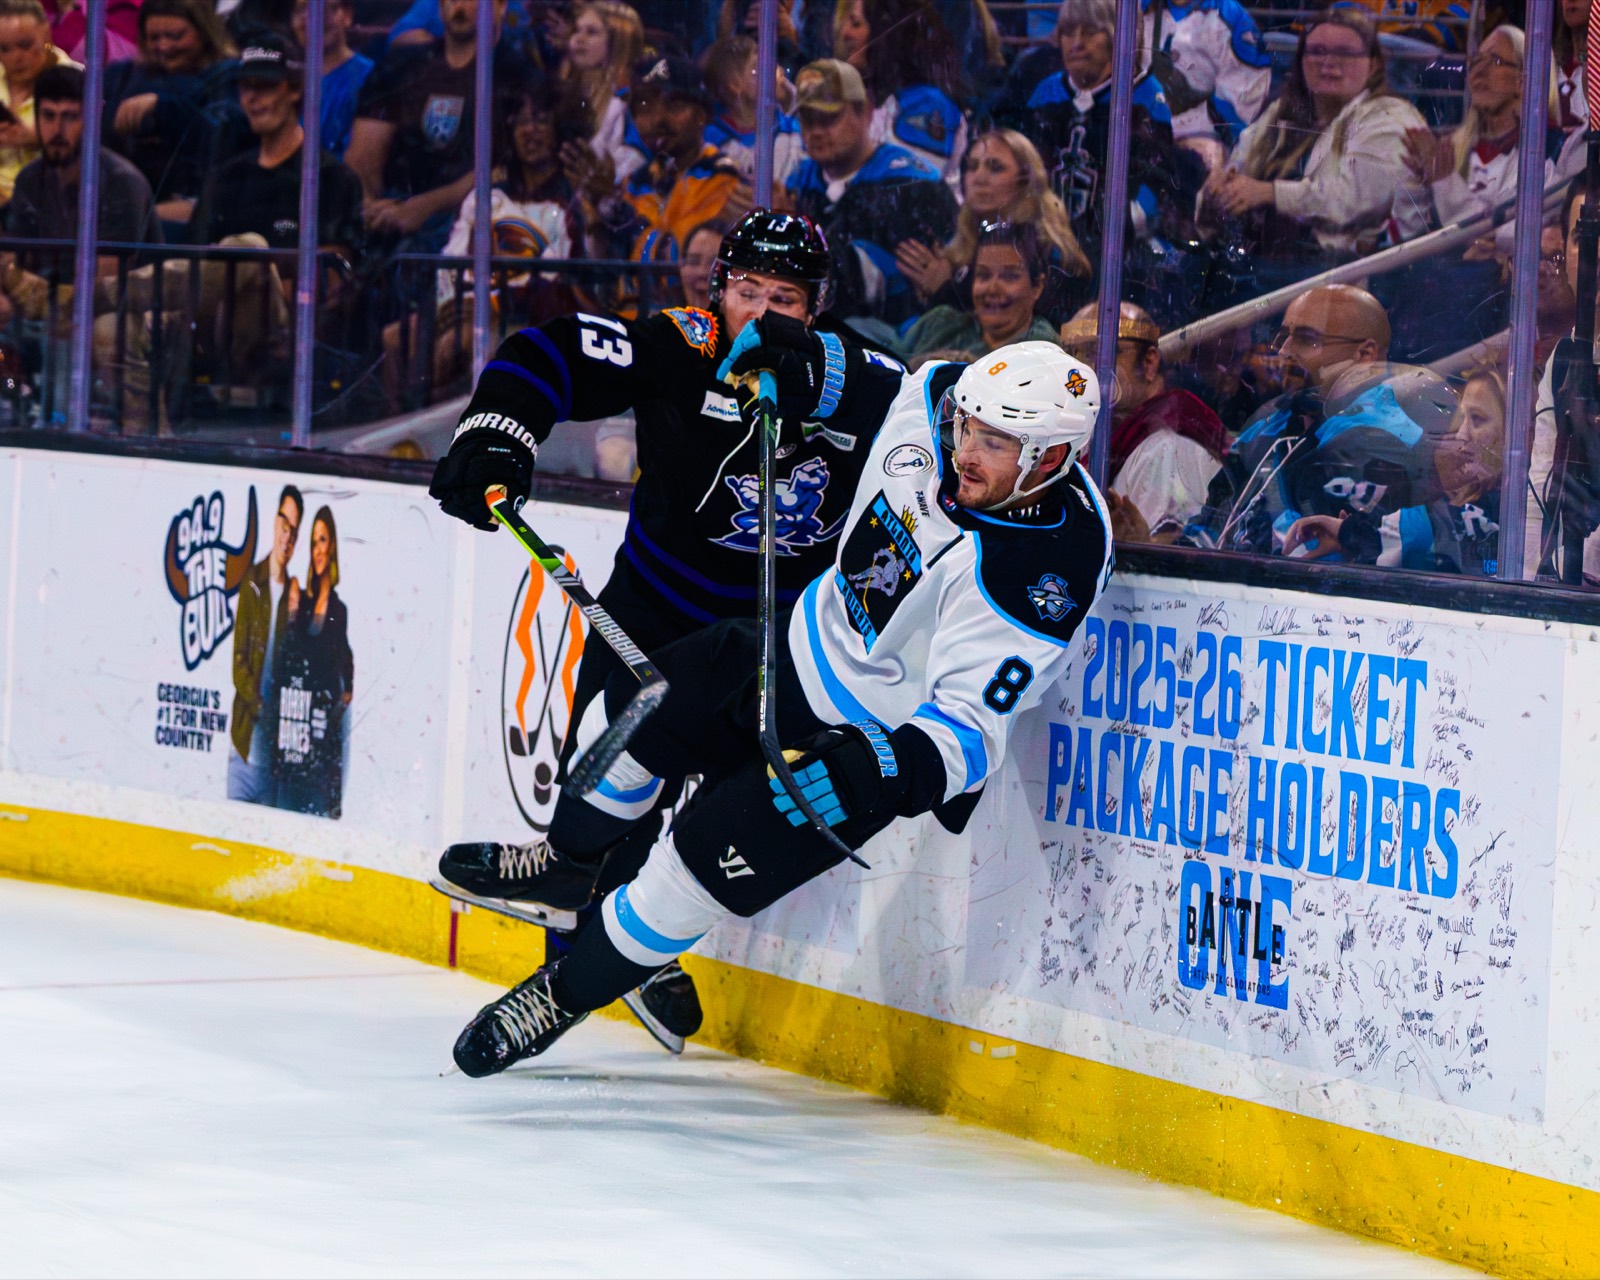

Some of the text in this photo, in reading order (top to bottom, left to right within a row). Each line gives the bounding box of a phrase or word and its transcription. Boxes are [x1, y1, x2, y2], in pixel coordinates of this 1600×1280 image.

[577, 312, 633, 367] 13
[989, 362, 1007, 376] 8
[177, 491, 223, 561] 94.9
[880, 510, 917, 564] ATLANTA
[184, 548, 226, 597] THE
[184, 589, 231, 666] BULL
[583, 603, 650, 666] WARRIOR
[840, 587, 873, 636] KNIGHTS
[157, 682, 221, 709] GEORGIA'S
[982, 655, 1034, 715] 8
[1083, 616, 1243, 738] 2025-26
[1256, 640, 1428, 769] TICKET
[155, 725, 213, 752] COUNTRY
[157, 706, 228, 733] #1 FOR NEW
[1045, 722, 1233, 857] PACKAGE
[1244, 756, 1461, 899] HOLDERS
[1178, 861, 1292, 1010] ONE
[1186, 878, 1283, 967] BATTLE
[1192, 970, 1271, 997] ATLANTA GLADIATORS
